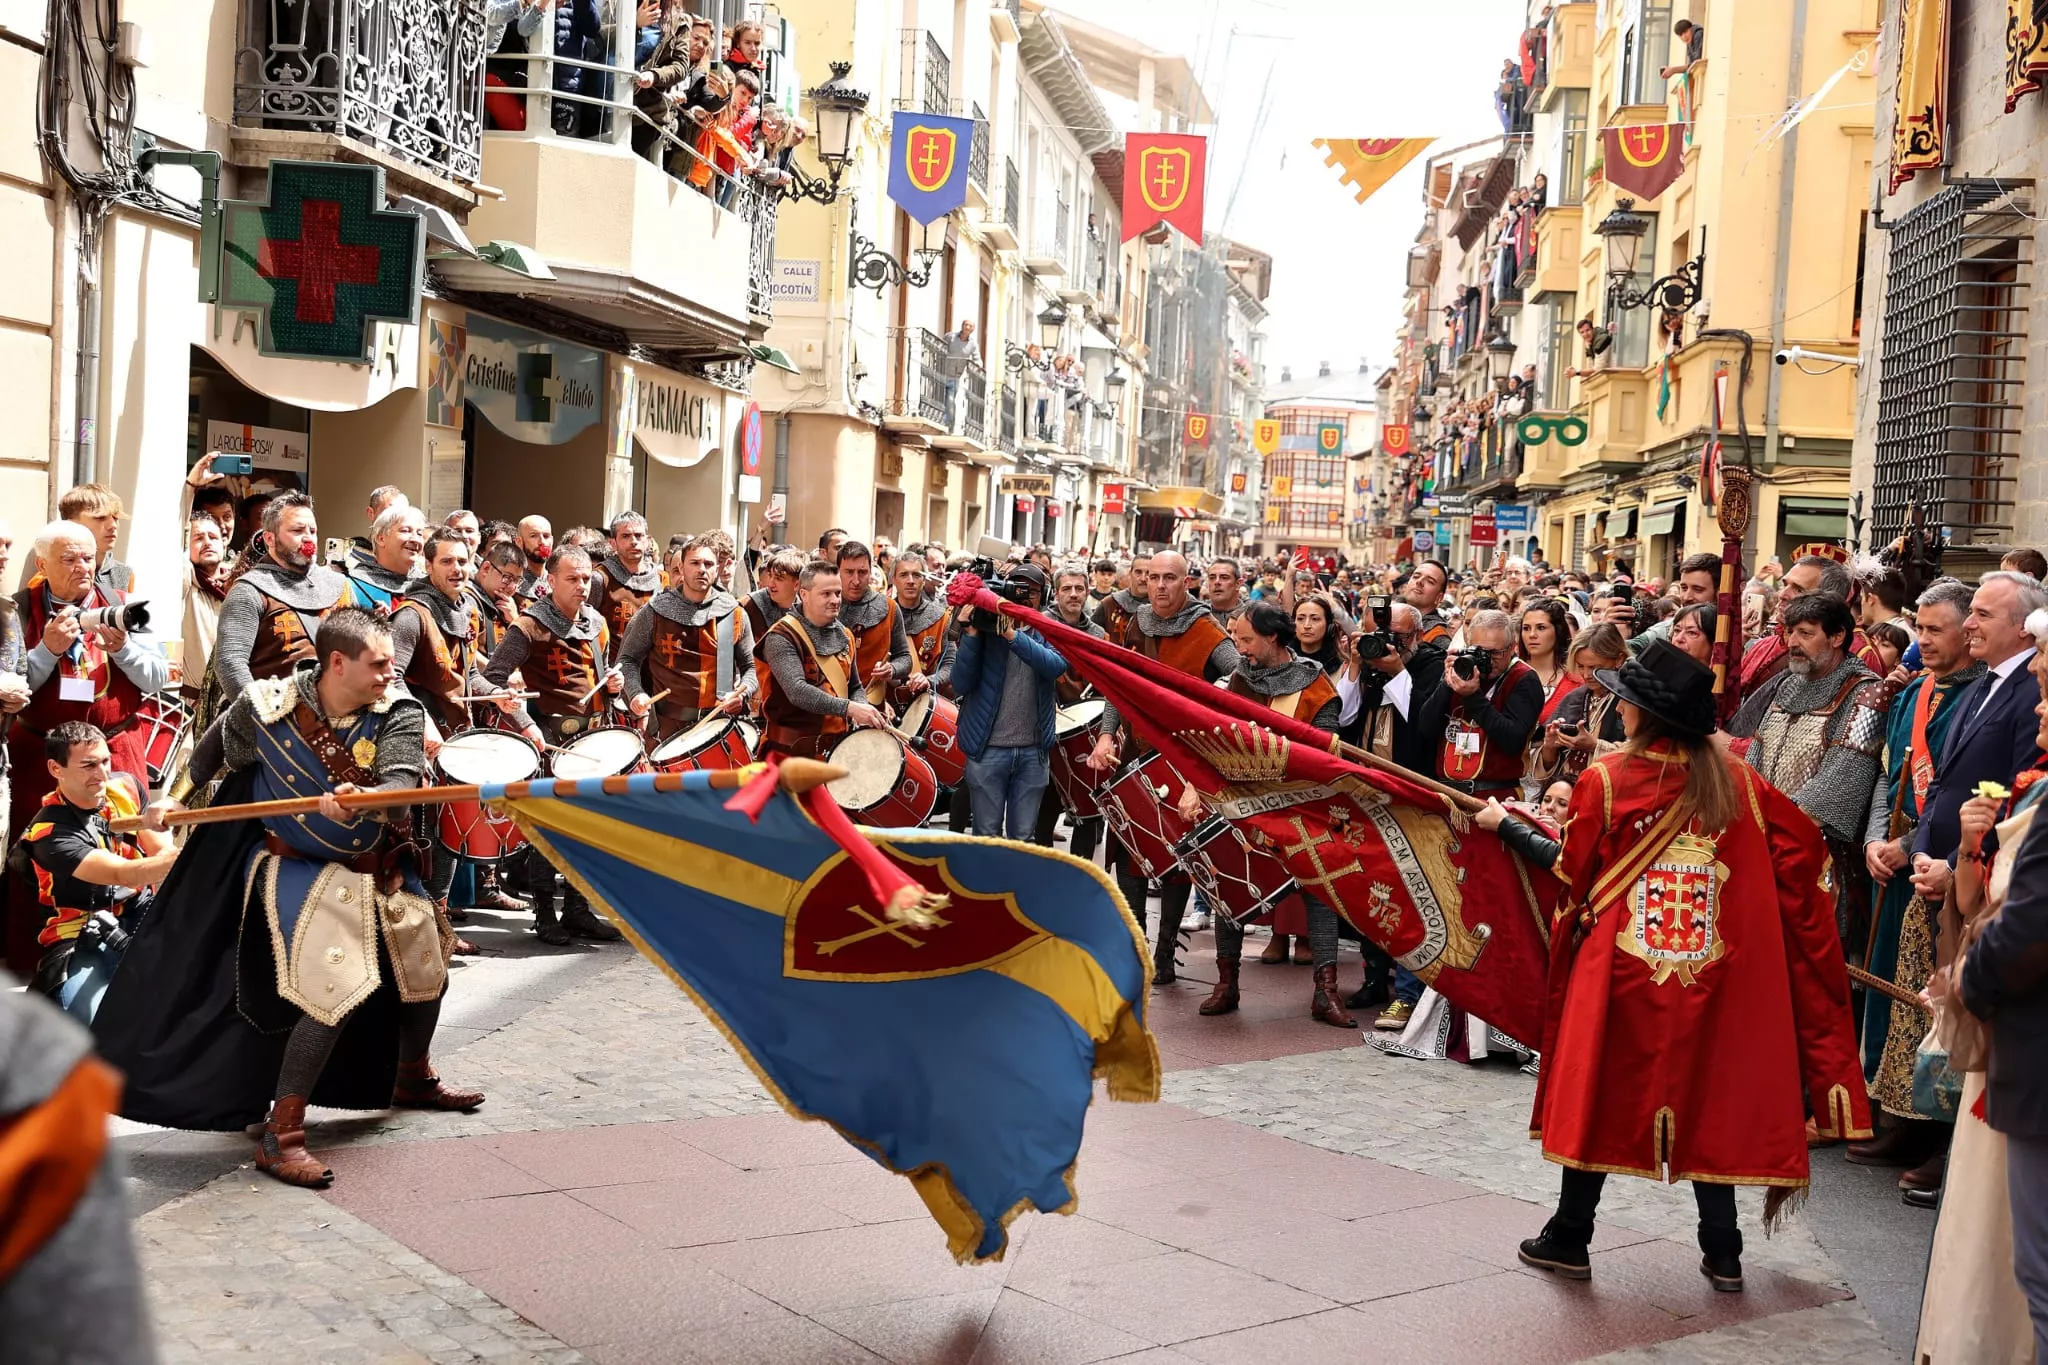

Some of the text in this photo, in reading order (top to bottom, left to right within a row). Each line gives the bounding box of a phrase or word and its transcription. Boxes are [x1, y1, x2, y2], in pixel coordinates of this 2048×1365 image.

[783, 267, 812, 276] CALLE
[770, 282, 812, 295] OCOTÍN
[466, 353, 516, 396] Cristina
[637, 380, 711, 442] FARMACIA
[251, 439, 274, 456] POSAY
